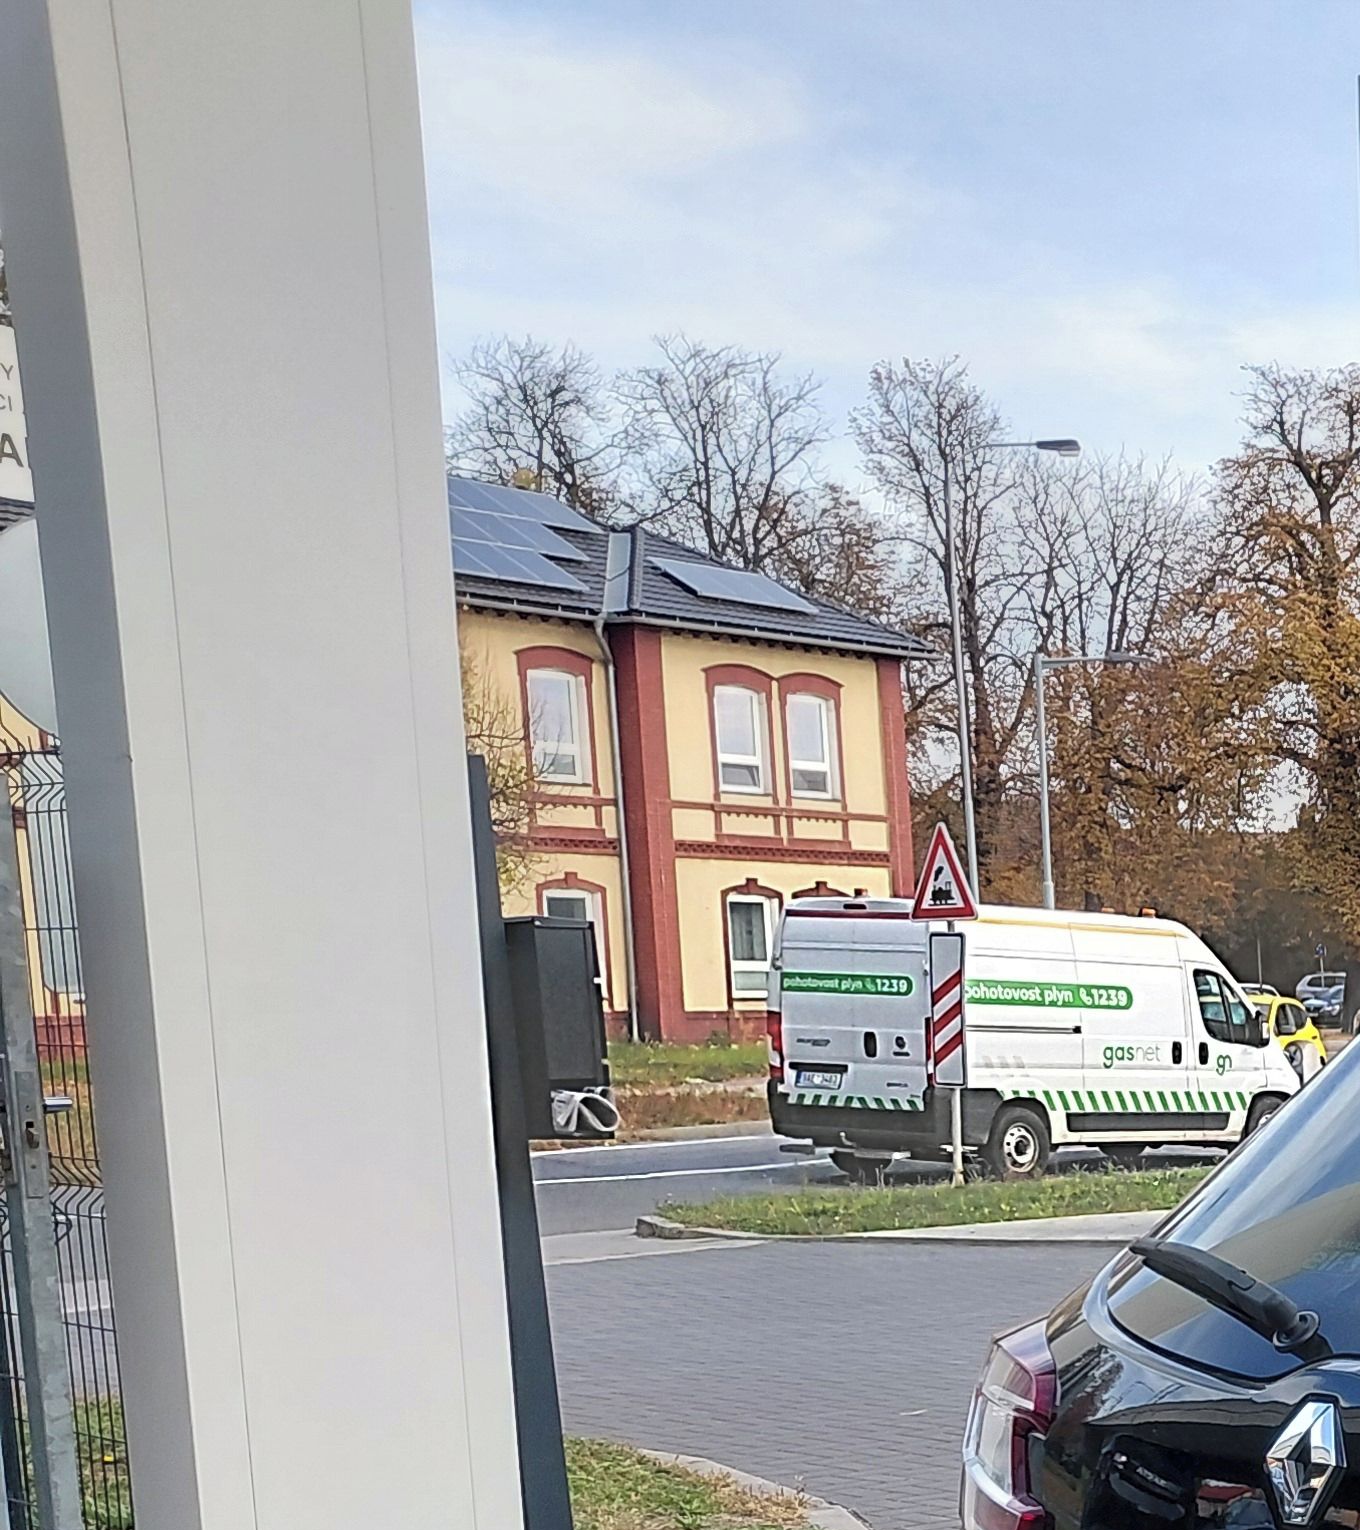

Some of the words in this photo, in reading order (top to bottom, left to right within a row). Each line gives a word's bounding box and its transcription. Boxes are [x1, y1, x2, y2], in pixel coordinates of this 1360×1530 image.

[875, 978, 909, 993] 1239
[1044, 985, 1074, 1006] plyn
[1091, 987, 1128, 1007] 1239
[1102, 1043, 1161, 1069] gasnet
